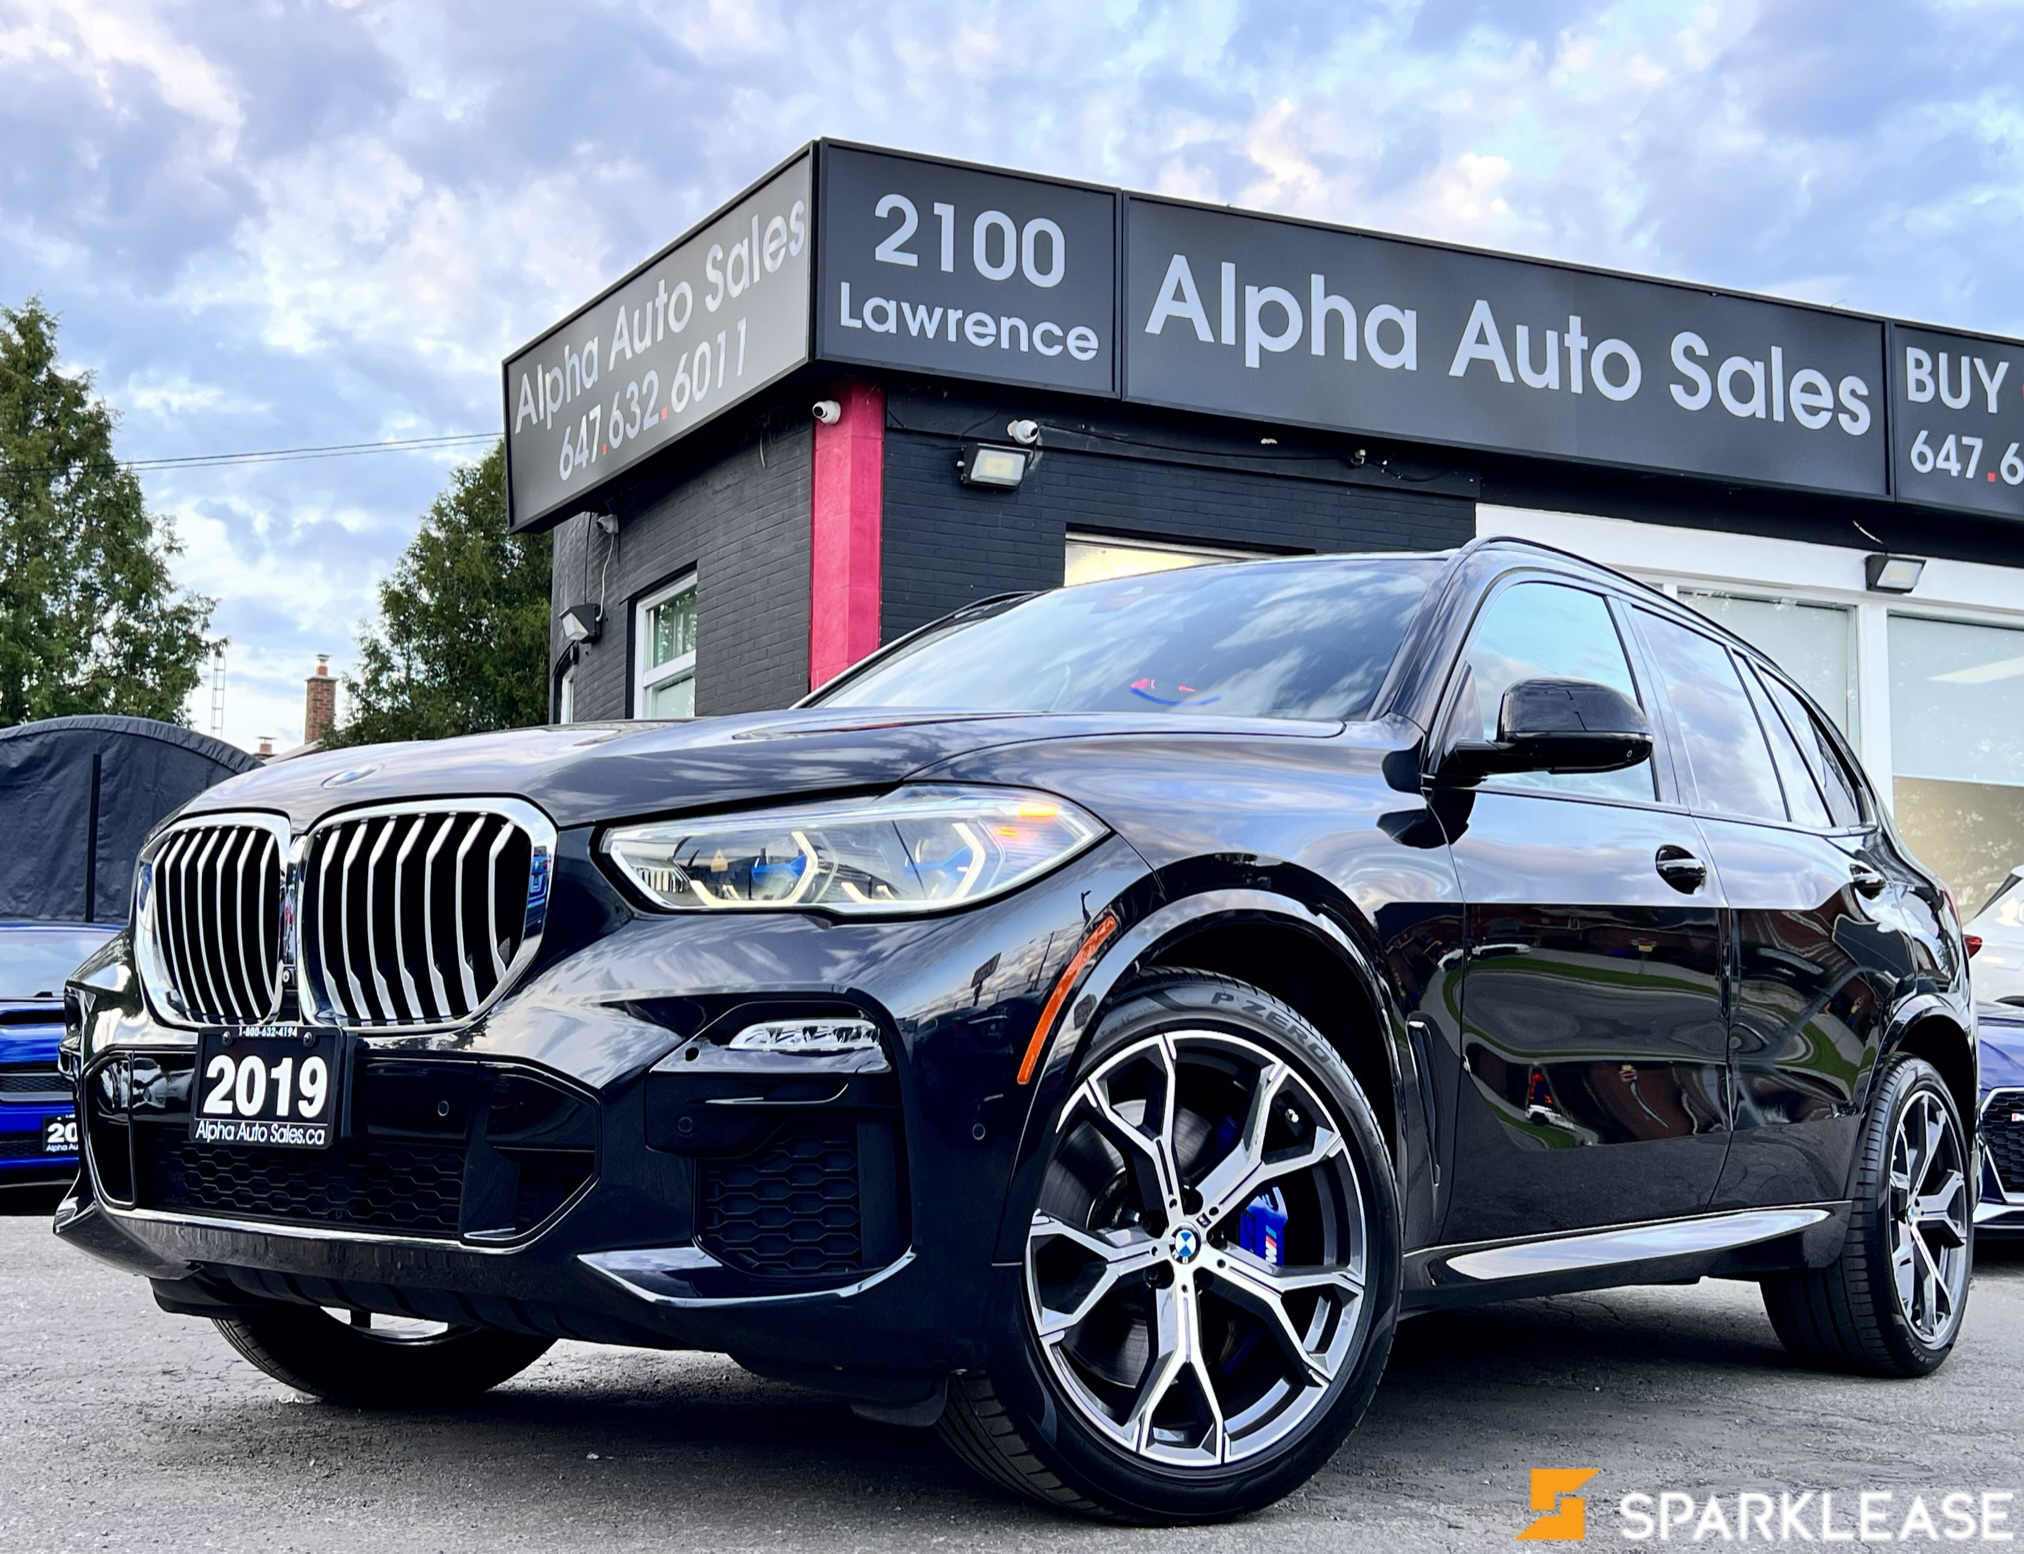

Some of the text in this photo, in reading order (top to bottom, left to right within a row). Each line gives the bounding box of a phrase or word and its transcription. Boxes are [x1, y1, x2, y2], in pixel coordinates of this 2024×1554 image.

[875, 193, 1066, 288] 2100
[515, 200, 805, 434] Alpha Auto Sales
[840, 281, 1099, 361] Lawrence
[1145, 254, 1872, 437] Alpha Auto Sales
[559, 317, 747, 481] 647.632.6011
[1906, 346, 2010, 414] BUY
[203, 1054, 328, 1119] 2019
[46, 1144, 68, 1152] Alpha
[195, 1121, 326, 1146] Alpha Auto Sales.ca
